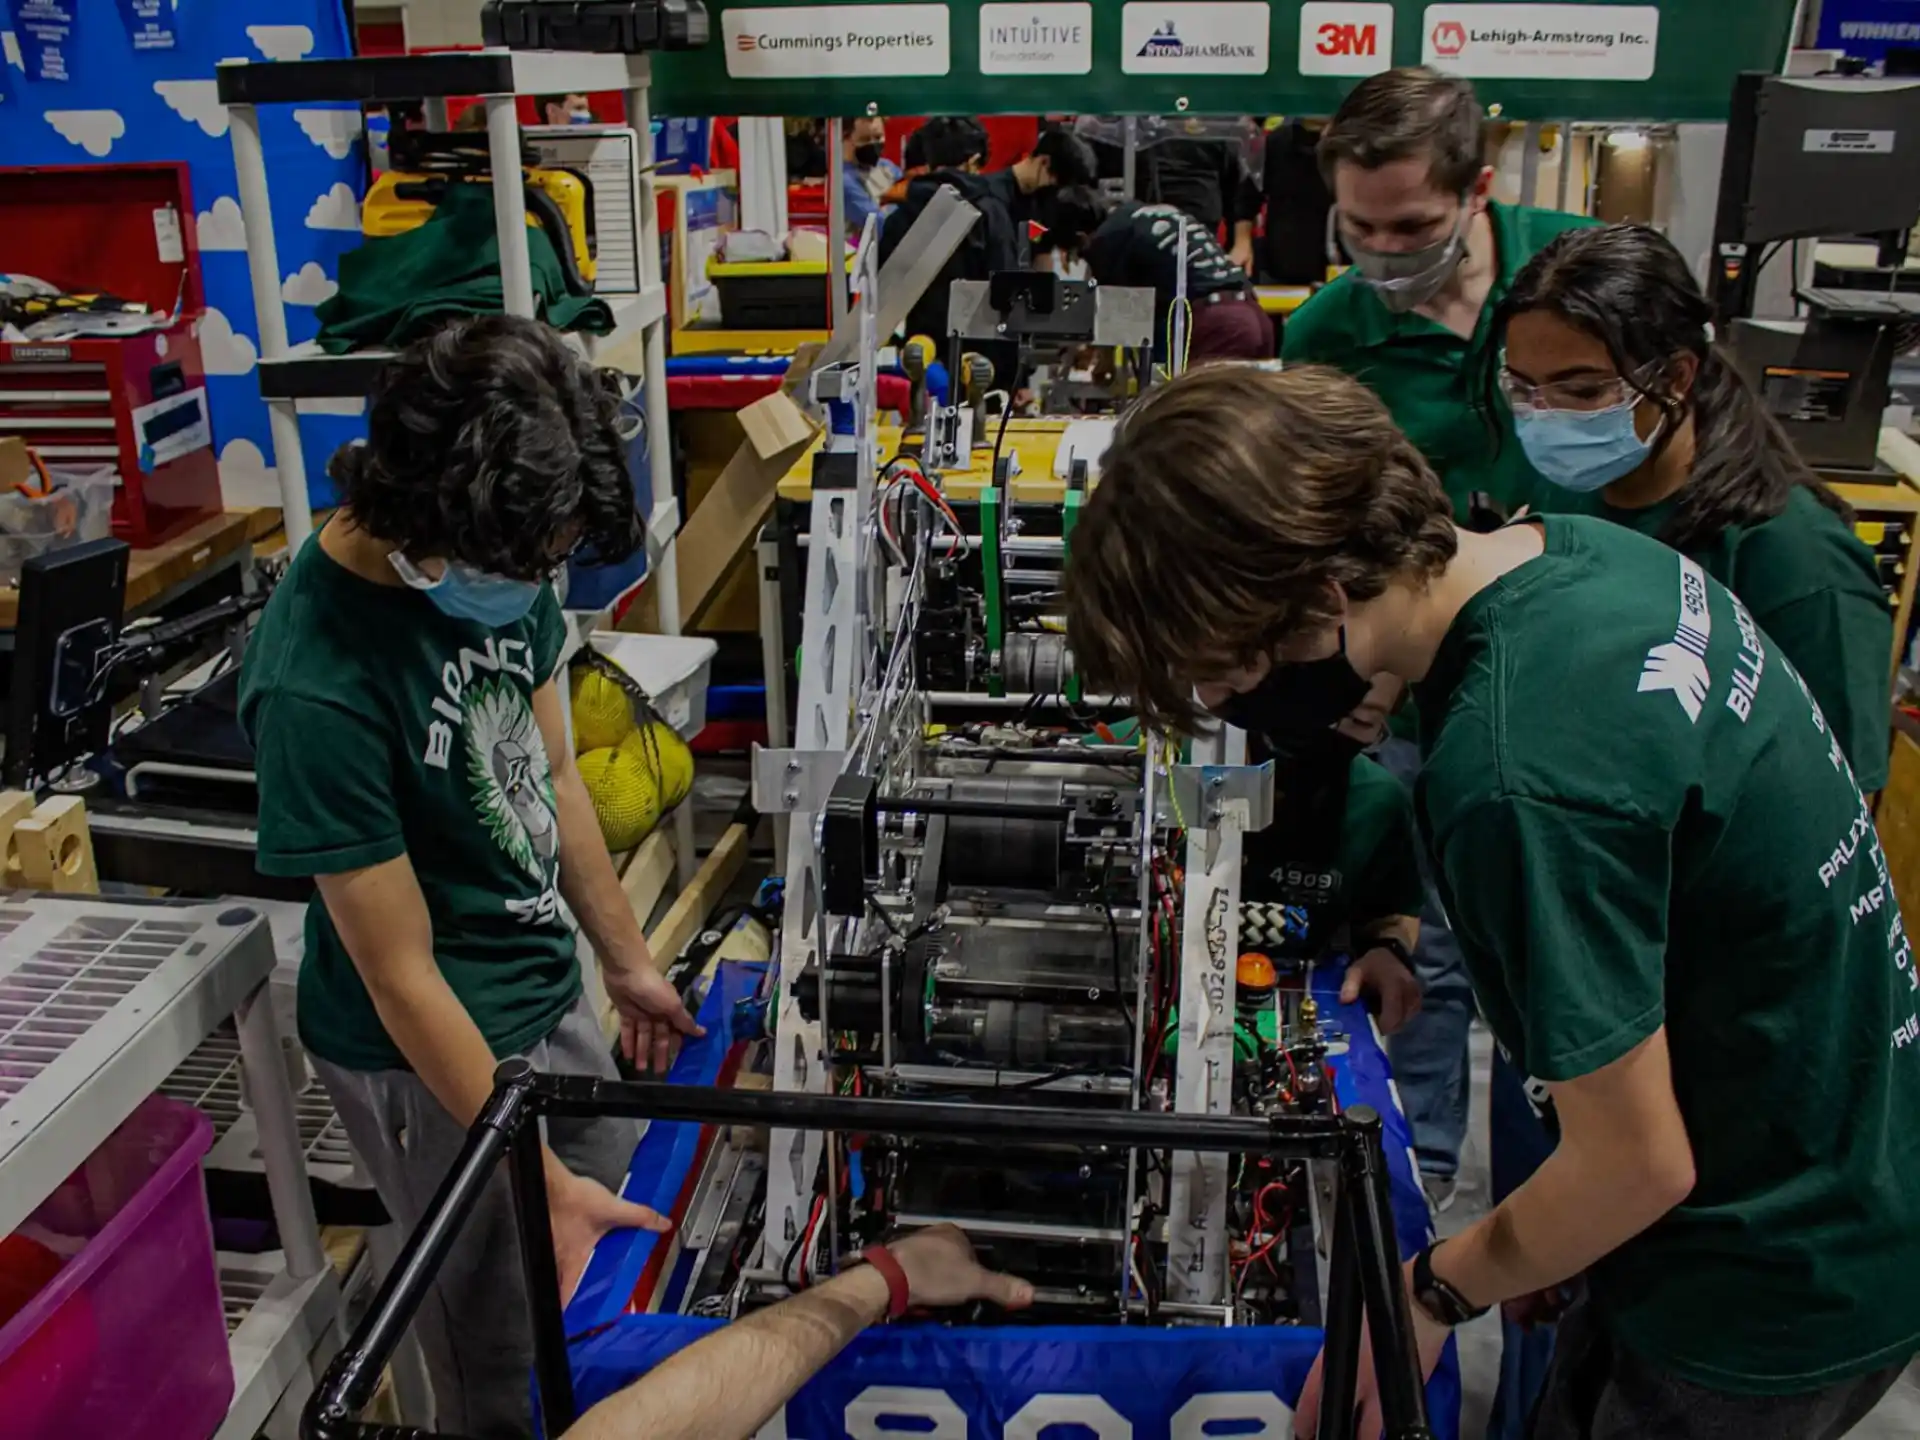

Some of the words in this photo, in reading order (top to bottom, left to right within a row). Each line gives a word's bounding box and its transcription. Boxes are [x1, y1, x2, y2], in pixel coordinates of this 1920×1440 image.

[758, 33, 843, 51] Cummings
[847, 31, 934, 50] Properties
[990, 17, 1081, 44] INTUITIVE
[1316, 23, 1376, 56] 3M
[1470, 28, 1614, 47] Lehigh-Armstrong
[1620, 32, 1649, 45] Inc.
[1684, 571, 1705, 616] 4909
[1268, 865, 1333, 890] 4909
